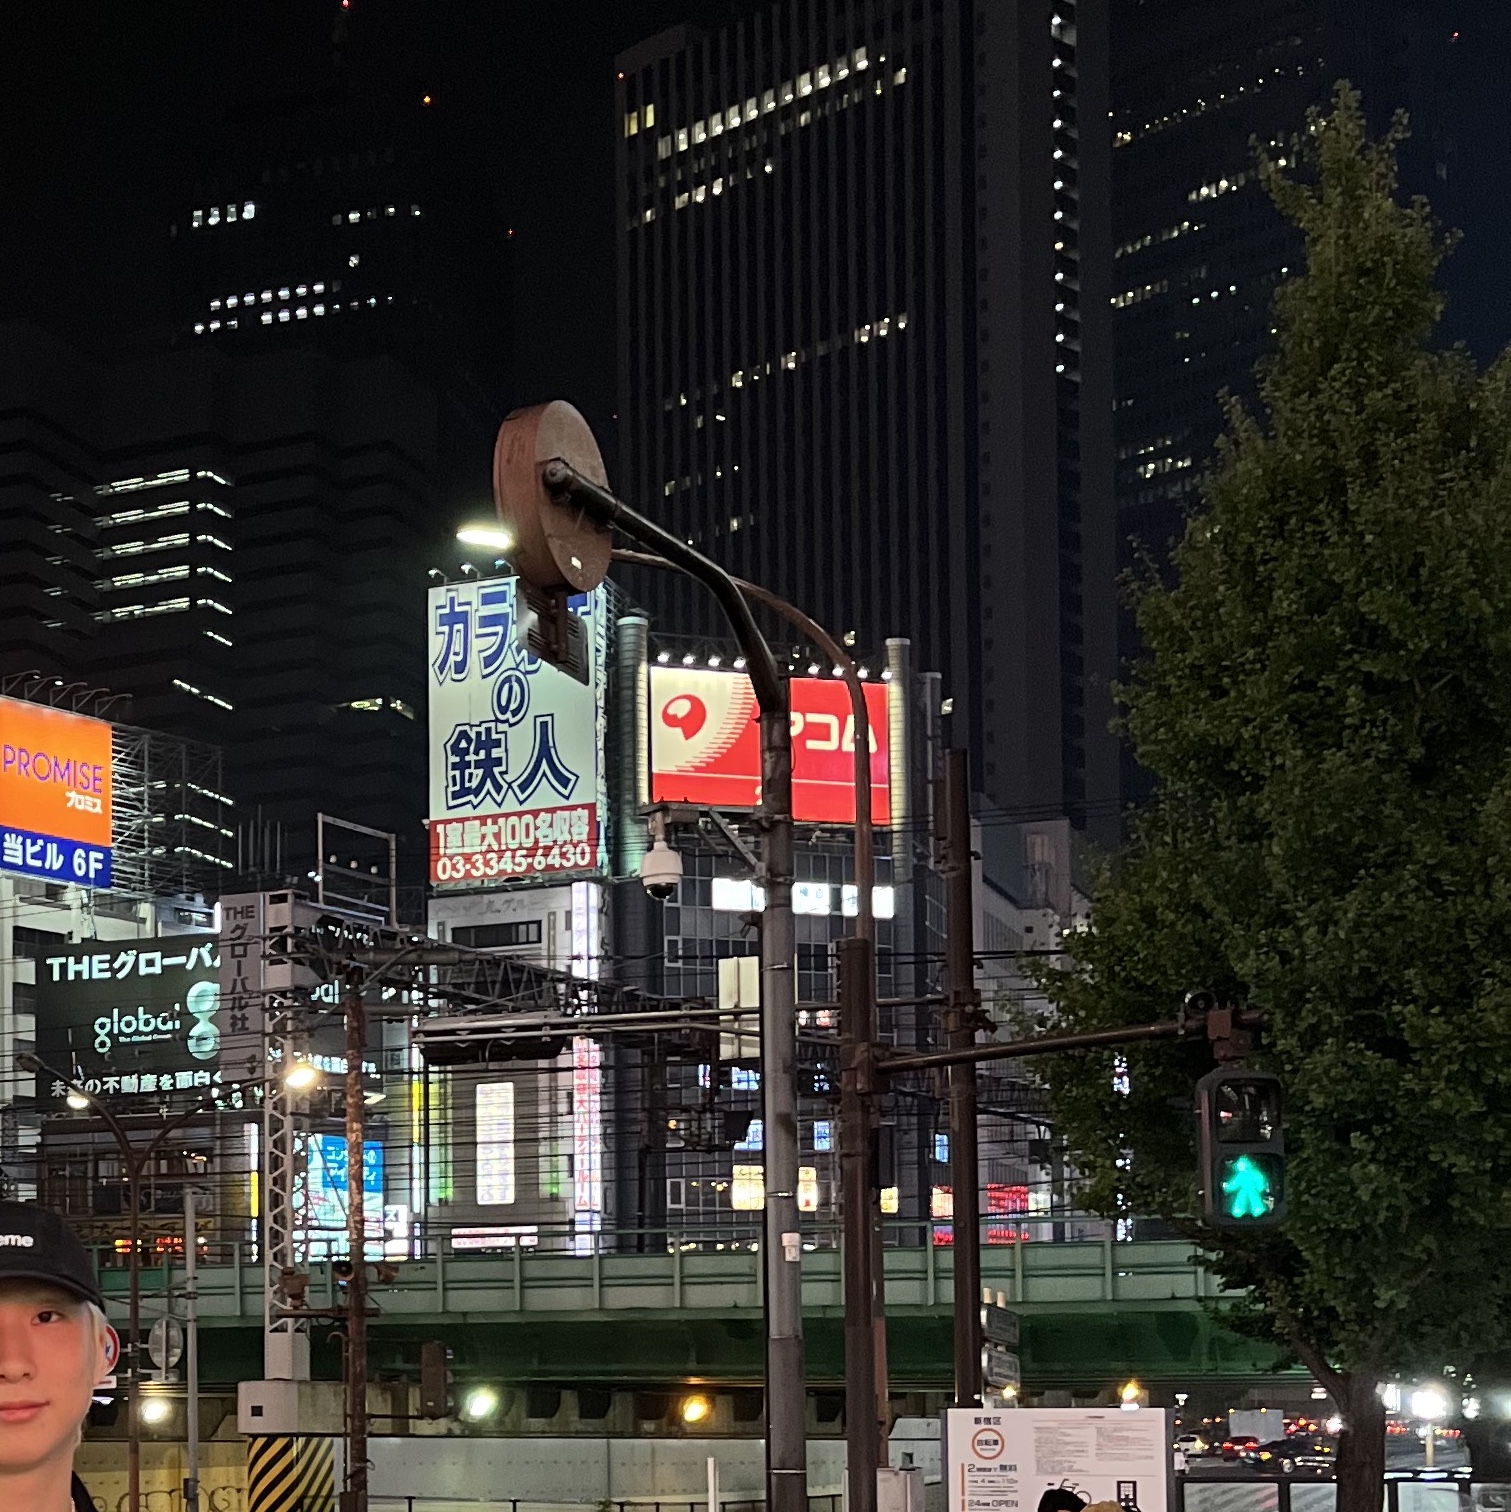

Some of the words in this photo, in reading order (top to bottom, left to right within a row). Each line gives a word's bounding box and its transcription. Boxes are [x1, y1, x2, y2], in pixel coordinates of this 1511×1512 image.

[492, 667, 530, 727] の
[2, 743, 105, 794] PROMISE
[444, 713, 580, 811] 鉄人
[65, 790, 104, 815] プロミス
[2, 832, 65, 872] 当ビル
[72, 847, 105, 879] 6F
[436, 808, 590, 857] 1室最大100名収容
[437, 844, 591, 882] 03-3345-6430
[45, 942, 221, 982] THEグローバ
[93, 1002, 181, 1053] global
